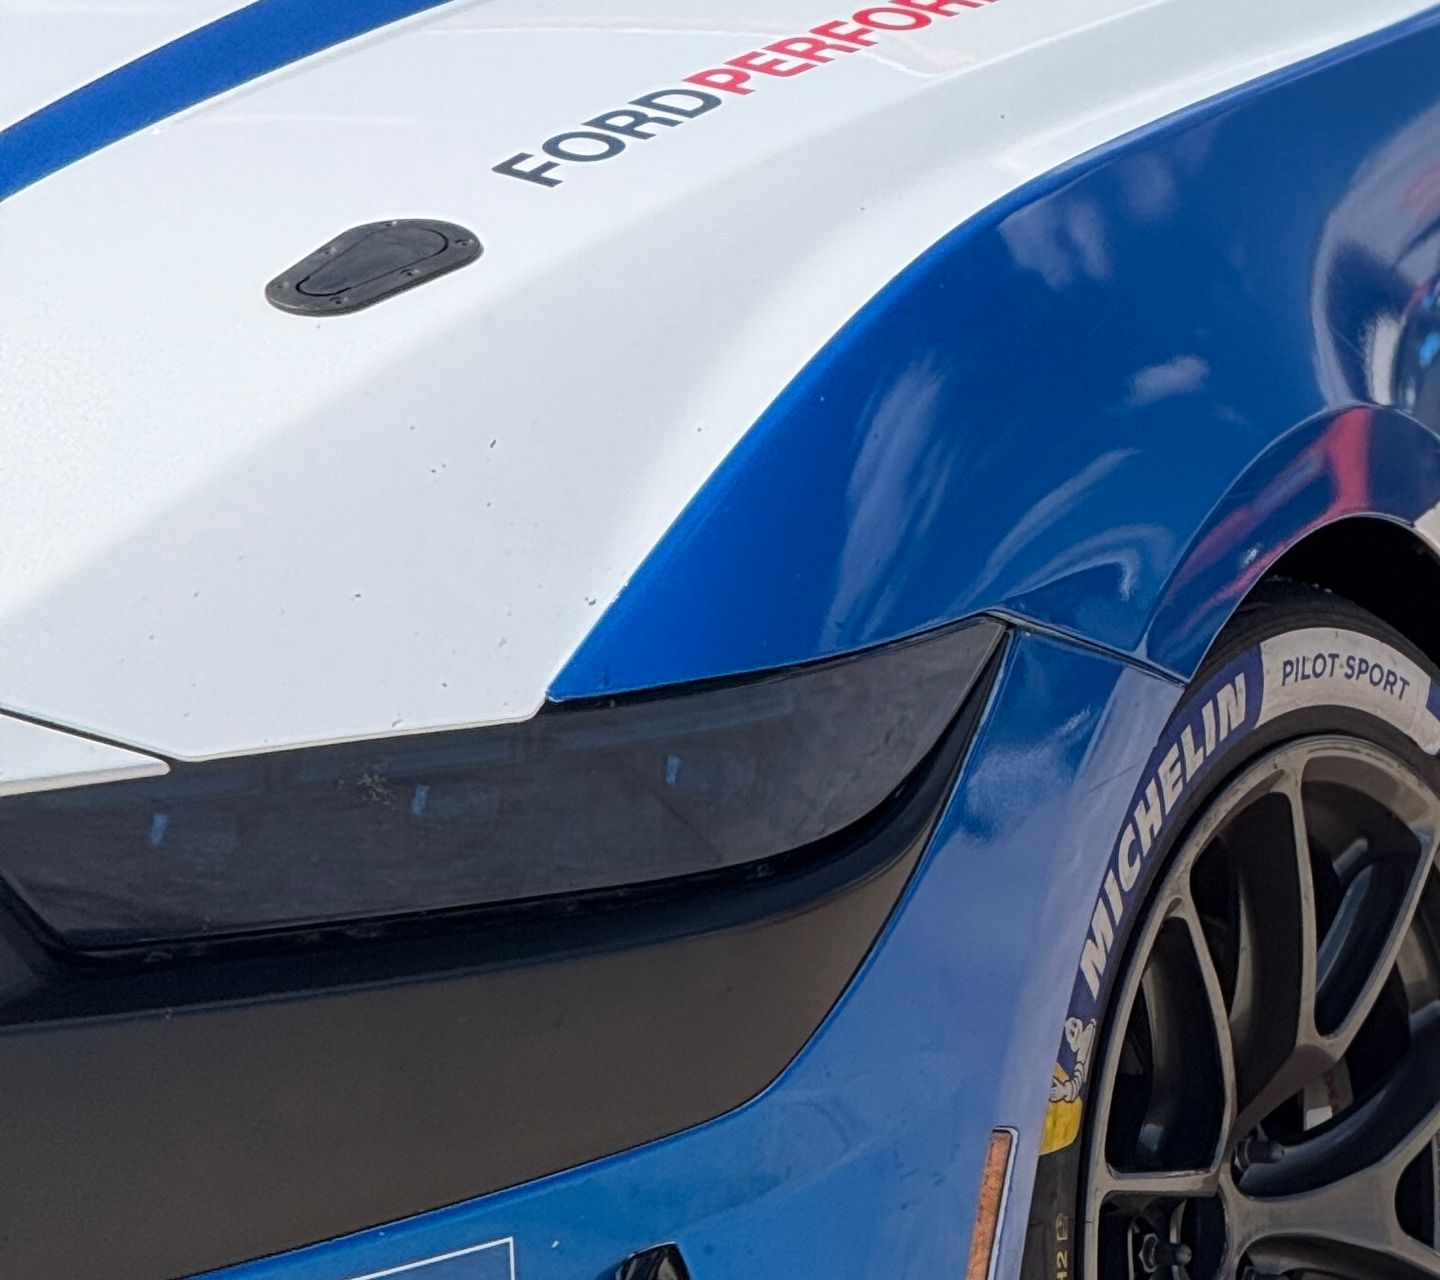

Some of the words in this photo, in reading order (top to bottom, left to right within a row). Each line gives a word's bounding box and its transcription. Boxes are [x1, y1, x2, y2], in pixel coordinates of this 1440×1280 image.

[1281, 653, 1340, 688] PILOT
[1343, 655, 1410, 700] SPORT
[1079, 672, 1247, 1000] MICHELIN
